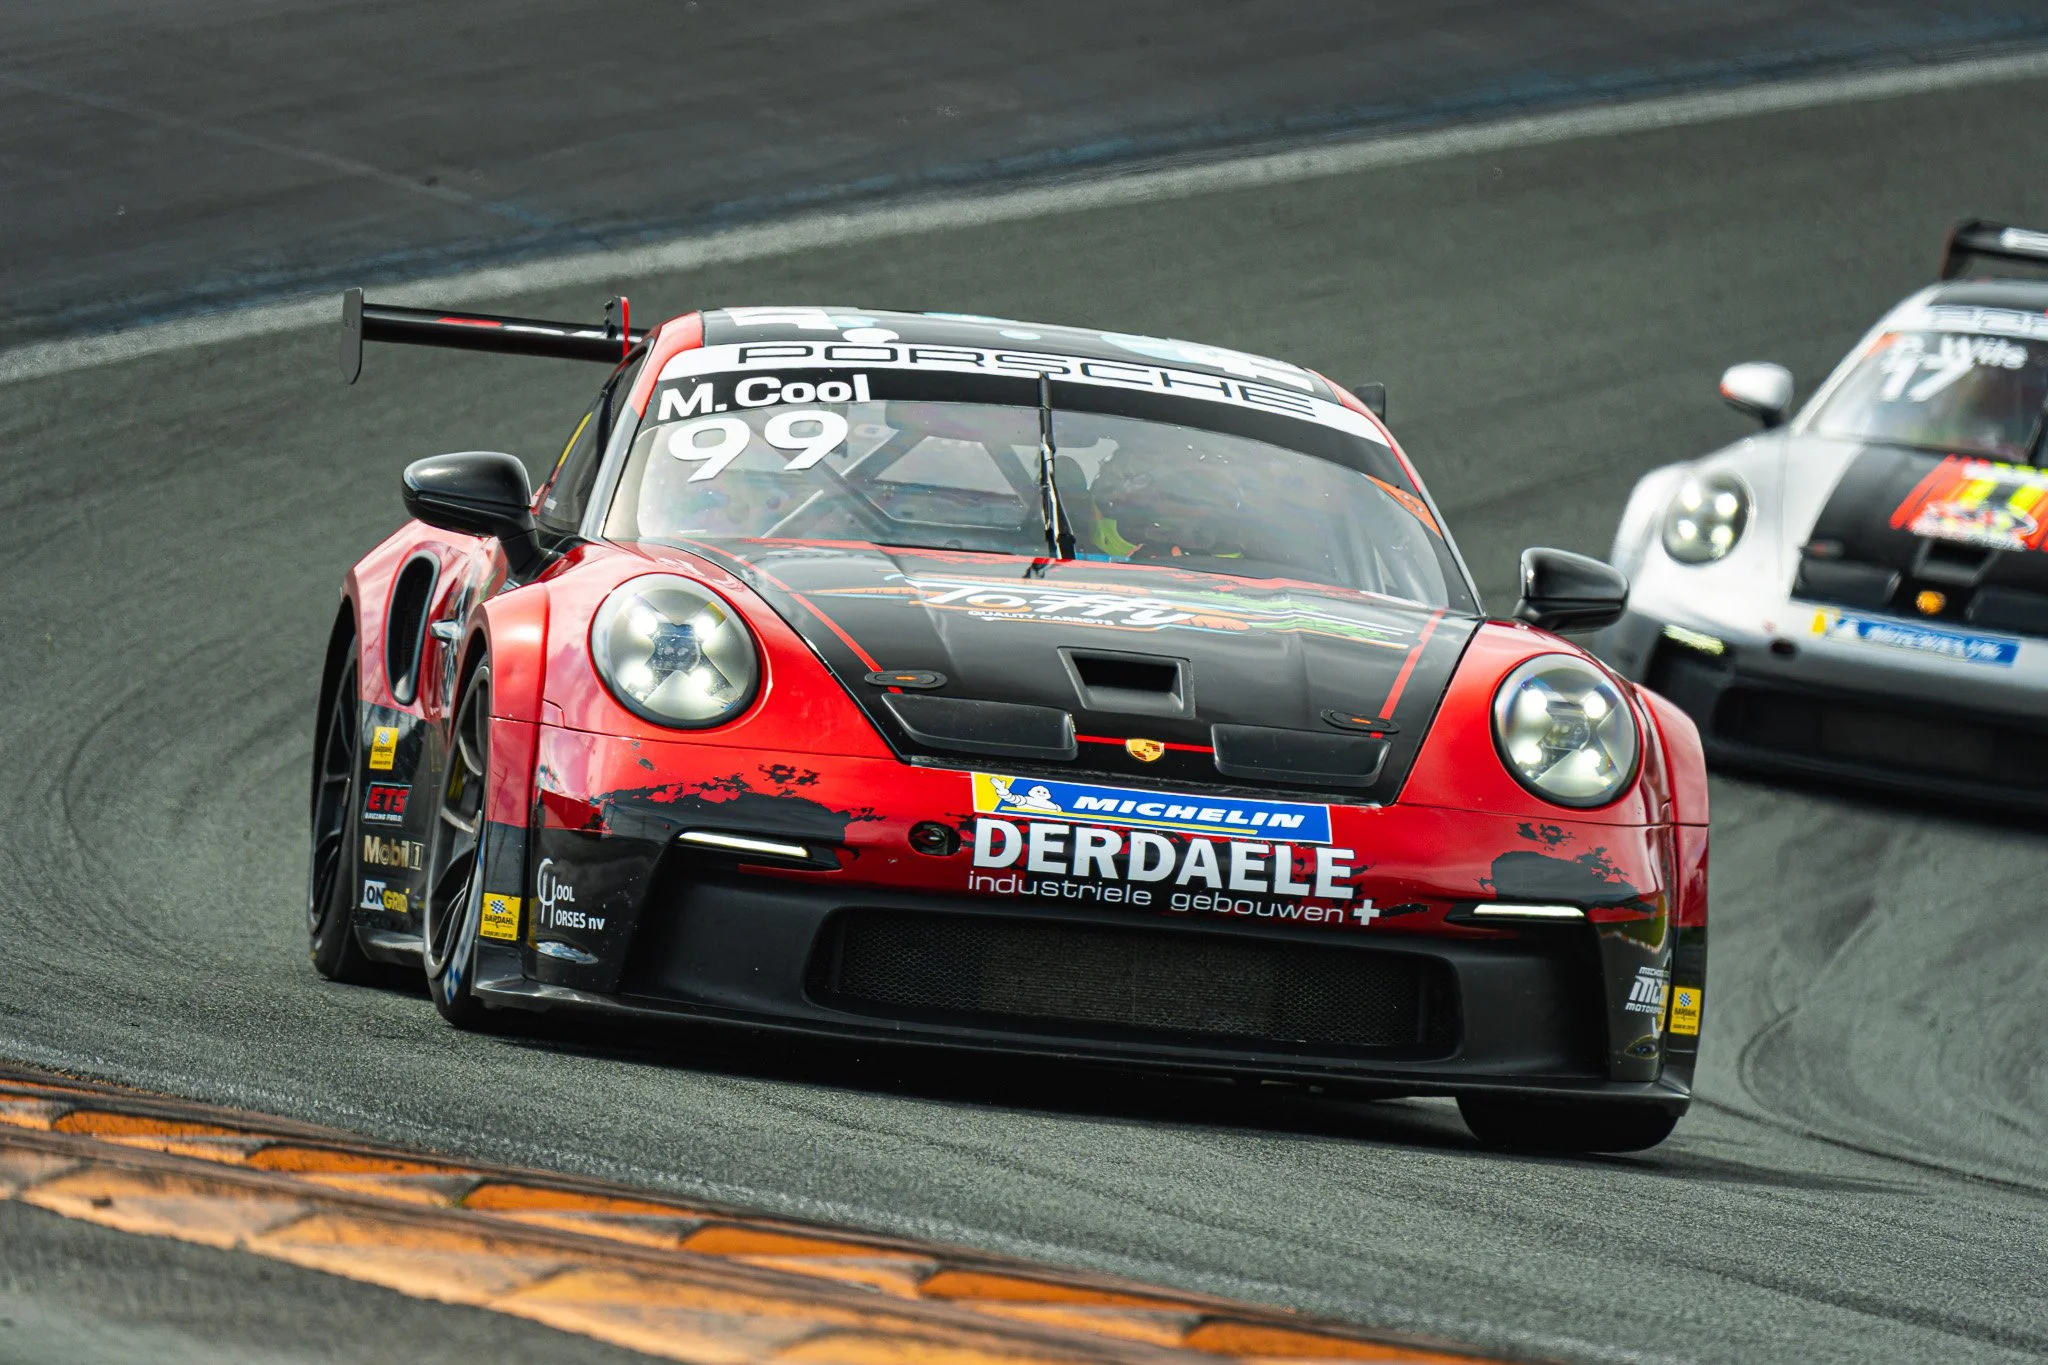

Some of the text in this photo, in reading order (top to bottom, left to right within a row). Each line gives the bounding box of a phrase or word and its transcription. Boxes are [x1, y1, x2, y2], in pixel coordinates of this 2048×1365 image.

[658, 374, 871, 421] M. Cool
[737, 345, 1316, 418] PORSCHE
[667, 409, 849, 484] 99
[967, 610, 1115, 626] QUALITY CARROTS
[368, 786, 410, 813] ETS
[1072, 795, 1306, 829] MICHELIN
[364, 834, 410, 869] Mobil
[972, 817, 1356, 900] DERDAELE
[968, 870, 1152, 906] industriele
[1170, 891, 1344, 923] gebouwen
[587, 917, 606, 931] nv
